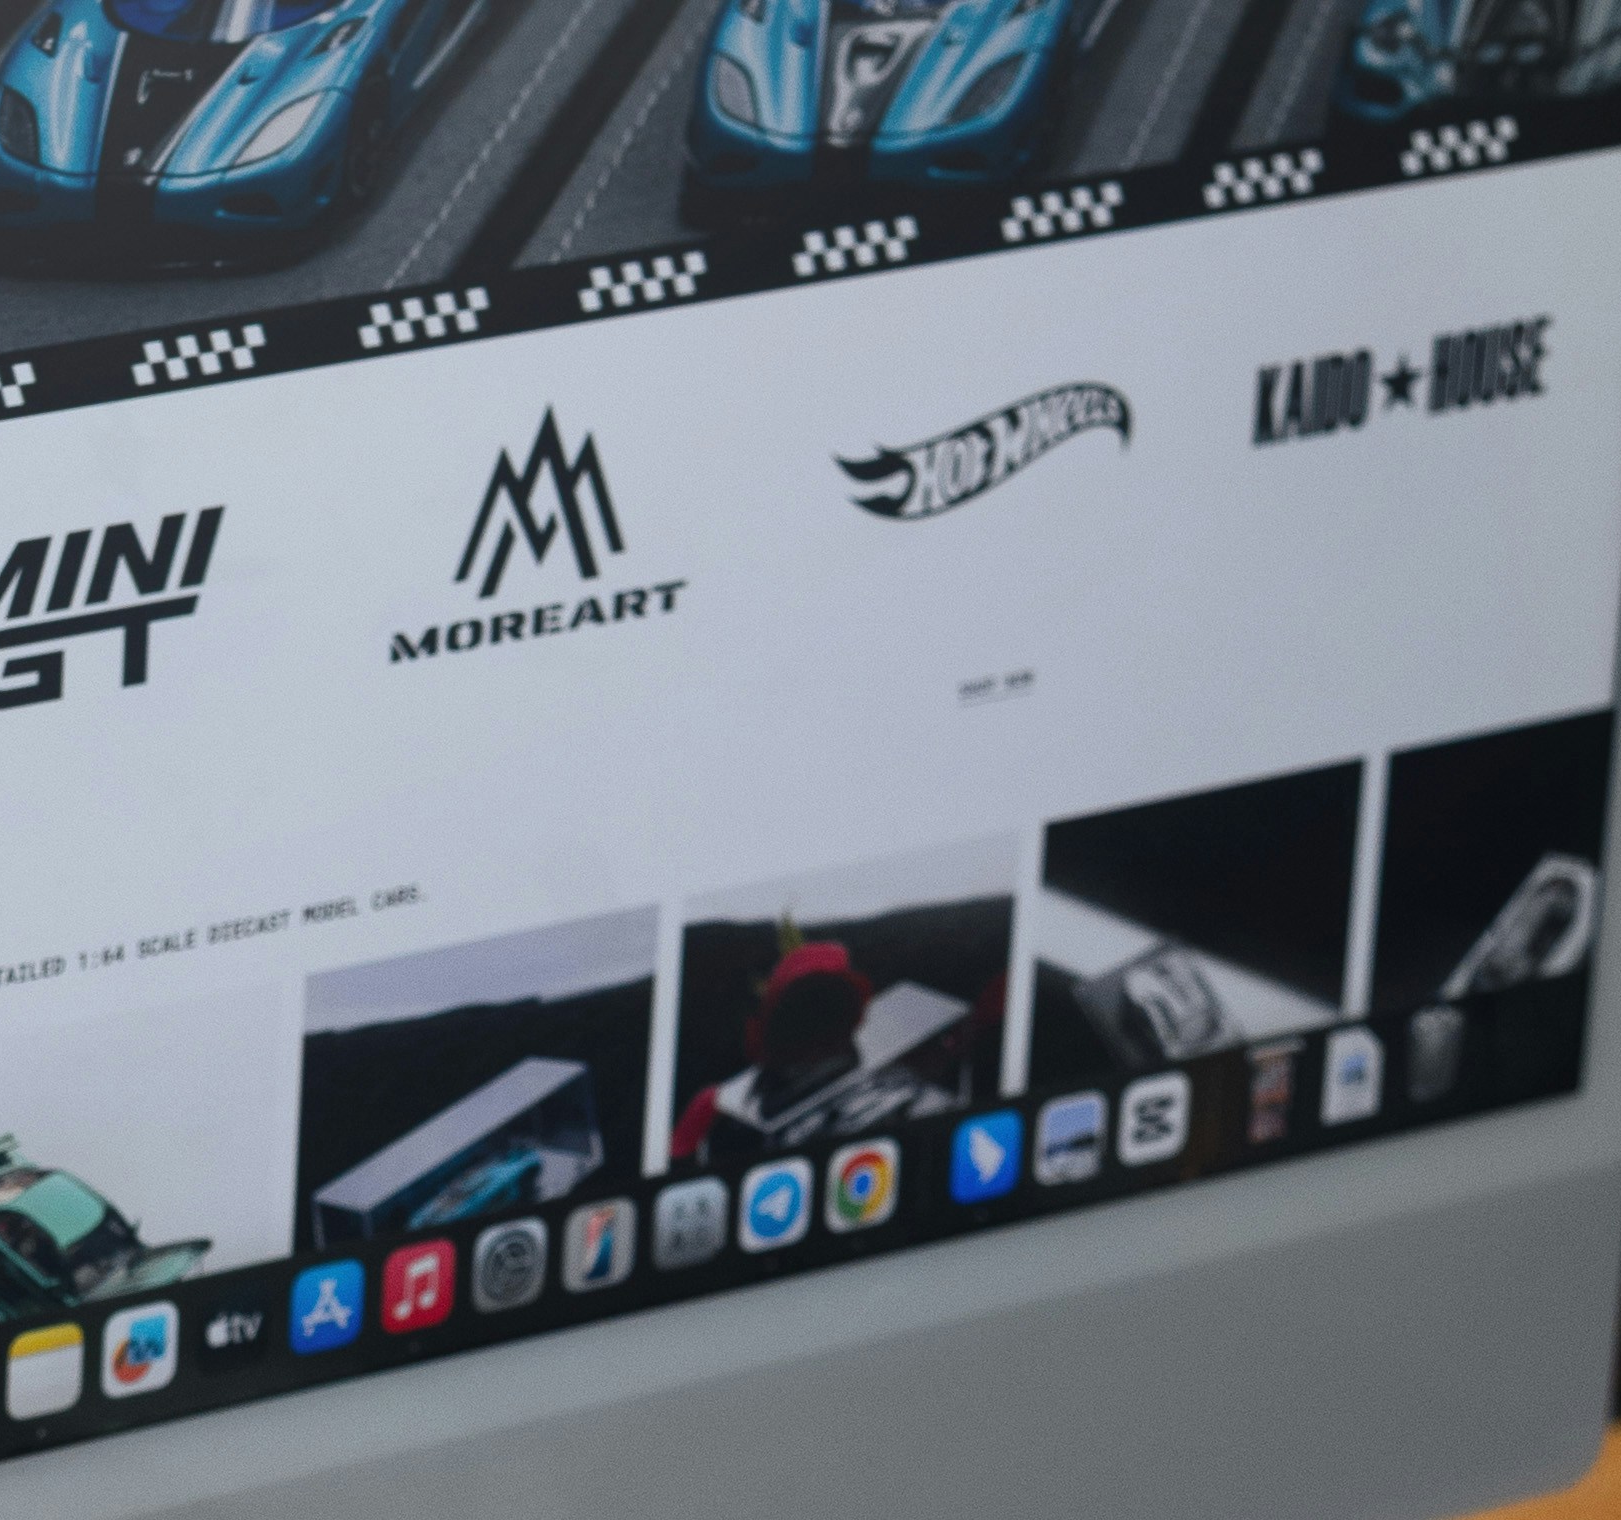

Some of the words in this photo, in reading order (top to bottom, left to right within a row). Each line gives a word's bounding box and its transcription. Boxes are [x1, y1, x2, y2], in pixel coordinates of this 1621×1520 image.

[389, 580, 687, 663] MOREART
[136, 927, 197, 960] SCALE
[206, 908, 291, 946] DIECAST
